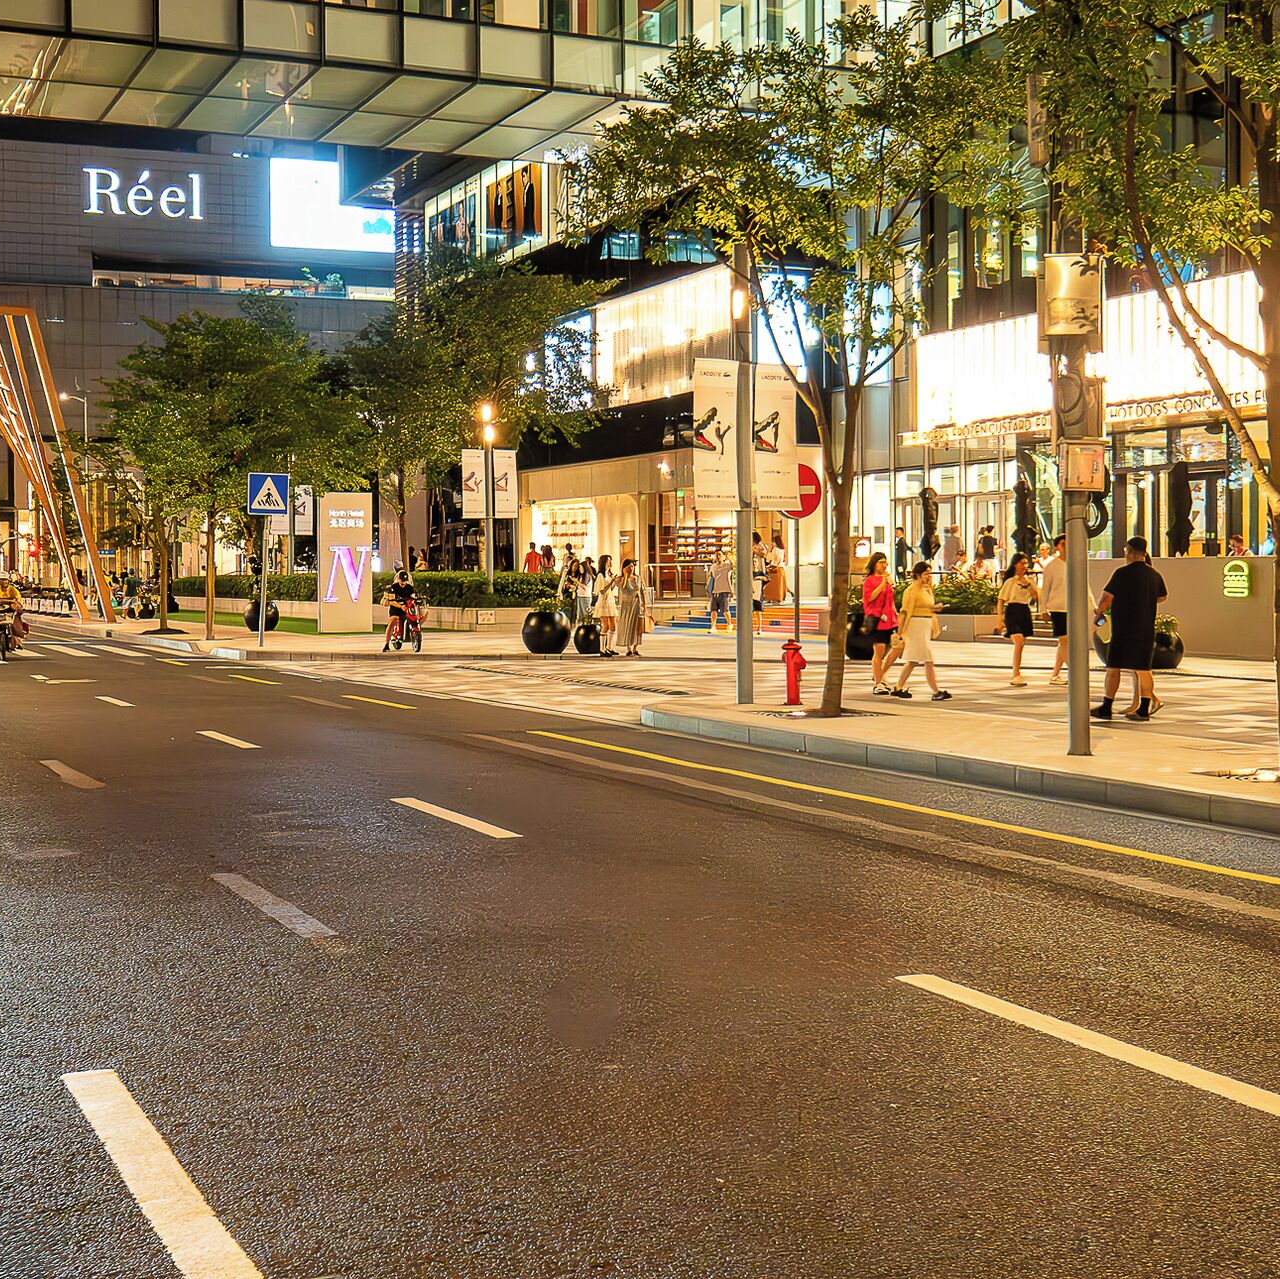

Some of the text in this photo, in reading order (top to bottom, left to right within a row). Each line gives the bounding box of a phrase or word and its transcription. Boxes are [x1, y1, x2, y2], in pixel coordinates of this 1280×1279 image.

[82, 167, 204, 219] Réel
[988, 419, 1032, 435] CUSTARD
[1110, 405, 1134, 418] HOT
[1136, 401, 1168, 418] DOGS
[1174, 390, 1248, 414] CONCRTES
[328, 509, 346, 517] North
[329, 518, 365, 528] 北区商场
[322, 546, 371, 603] N
